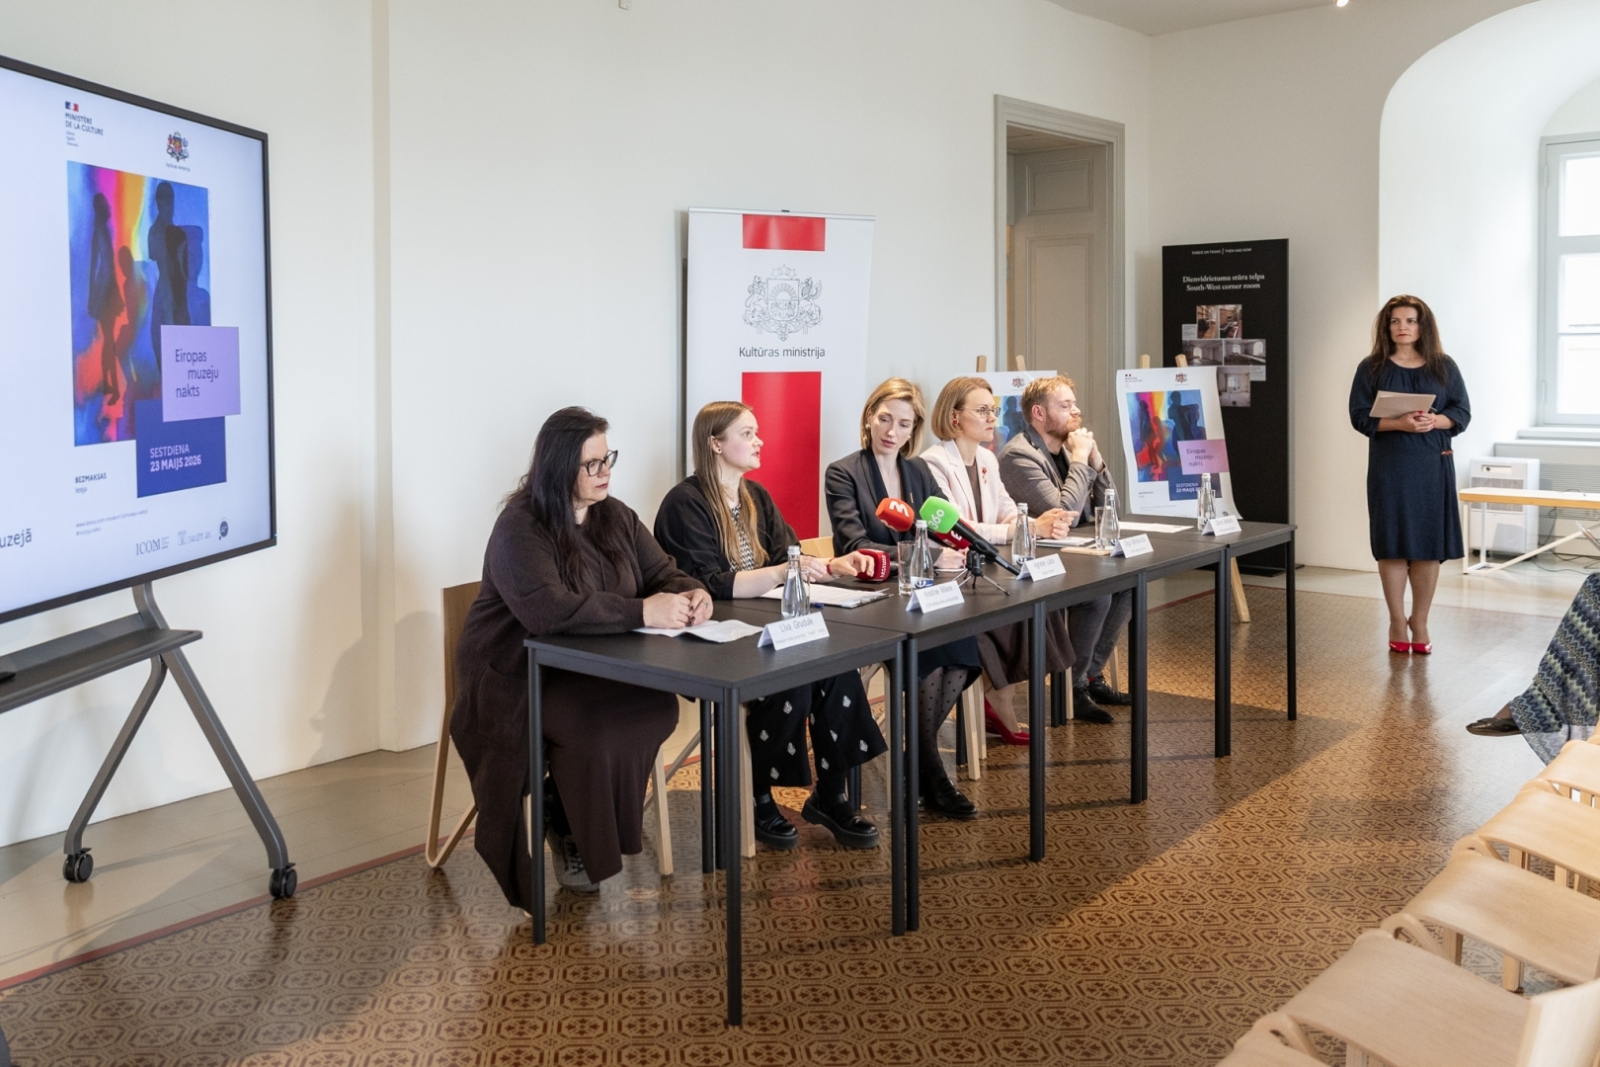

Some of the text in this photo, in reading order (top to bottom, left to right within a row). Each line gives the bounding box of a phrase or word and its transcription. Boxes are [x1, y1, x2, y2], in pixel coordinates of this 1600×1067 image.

[82, 125, 104, 136] CULTURE
[1249, 273, 1265, 282] telpa
[1186, 283, 1221, 292] South-West
[175, 348, 207, 366] Eiropas
[739, 347, 825, 359] Kultūras ministrija
[188, 365, 219, 383] muzeju
[176, 384, 200, 398] nakts
[150, 443, 190, 458] SESTDIENA
[1186, 448, 1206, 456] Eiropas
[150, 455, 202, 472] 23 MAIJS 2026
[75, 472, 107, 484] BEZMAKSAS
[928, 509, 945, 530] 360
[136, 538, 160, 556] ICOM
